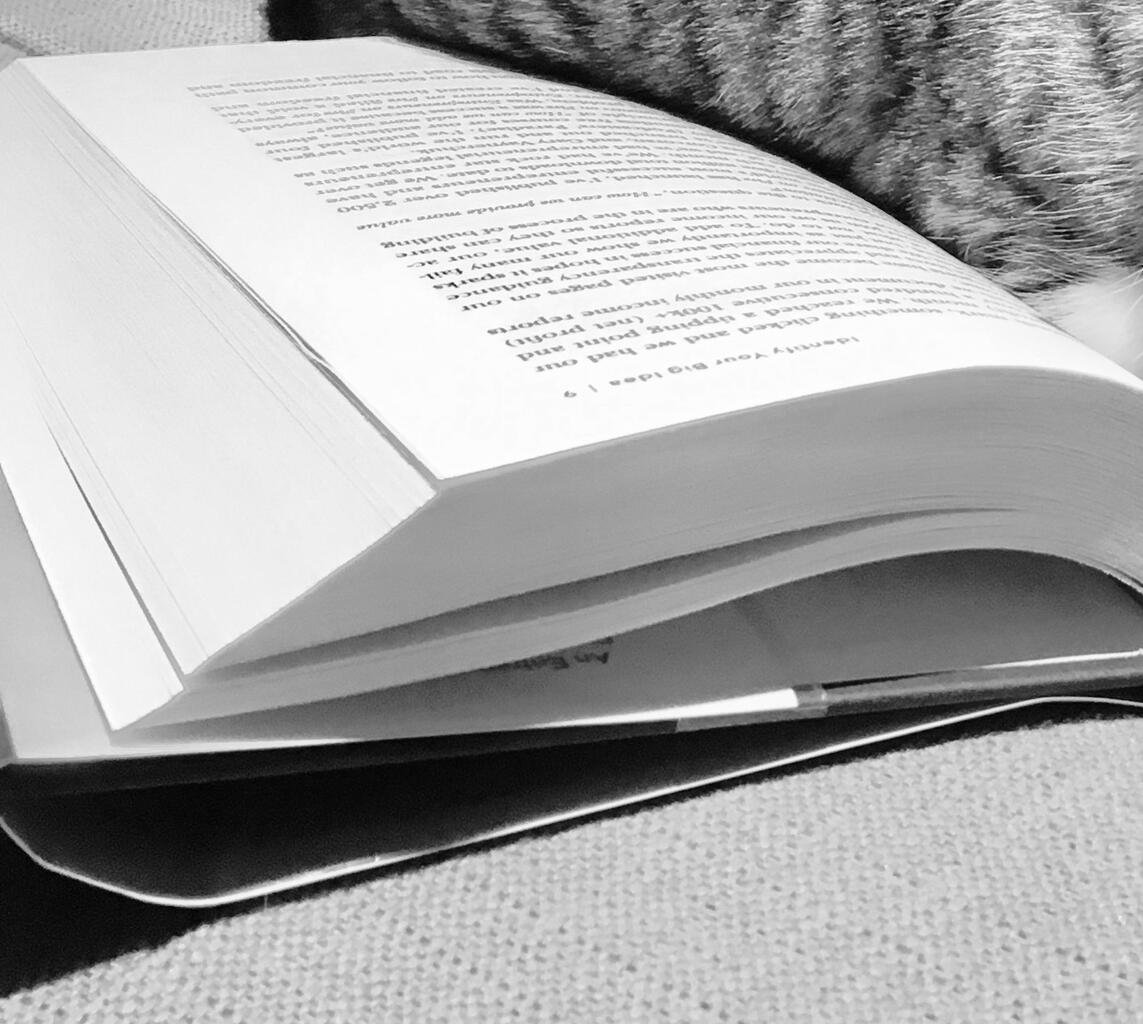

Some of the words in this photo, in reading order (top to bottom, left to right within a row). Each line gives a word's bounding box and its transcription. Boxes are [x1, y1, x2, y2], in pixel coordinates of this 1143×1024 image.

[432, 170, 580, 189] entrepreneurs
[383, 186, 425, 196] and
[455, 179, 558, 197] published
[326, 193, 378, 203] have
[403, 193, 449, 203] over
[337, 200, 397, 213] 2,500
[466, 200, 535, 214] provide
[417, 211, 463, 221] more
[508, 215, 588, 230] process
[356, 218, 413, 230] value
[590, 219, 666, 230] reports
[684, 224, 725, 232] add
[482, 227, 504, 235] of
[510, 231, 557, 241] they
[569, 227, 679, 245] additional
[683, 230, 803, 241] importantly
[380, 231, 480, 248] building
[463, 238, 503, 247] can
[711, 240, 802, 250] financial
[396, 245, 457, 258] share
[587, 242, 641, 253] show
[631, 246, 708, 258] success
[448, 252, 489, 262] our
[541, 251, 580, 259] our
[471, 257, 532, 270] many
[533, 259, 601, 272] hopes
[561, 257, 701, 281] transparency
[695, 264, 749, 273] most
[433, 273, 507, 289] sparks
[620, 271, 691, 285] visited
[775, 280, 811, 288] our
[447, 277, 554, 300] guidance
[548, 280, 613, 295] pages
[676, 285, 769, 302] monthly
[510, 293, 541, 301] on
[733, 288, 859, 306] consecutive
[461, 300, 502, 311] our
[582, 298, 671, 316] income
[656, 304, 723, 318] 100k+
[764, 300, 856, 316] reached
[825, 308, 943, 319] something
[488, 314, 574, 335] reports
[592, 316, 644, 329] (net
[647, 316, 736, 334] tipping
[739, 317, 820, 334] clicked
[505, 325, 586, 347] profit)
[573, 329, 641, 348] point
[684, 331, 730, 344] and
[646, 341, 677, 350] we
[774, 337, 860, 354] Identify
[517, 345, 565, 361] and
[588, 348, 638, 363] had
[717, 353, 769, 365] Your
[536, 359, 578, 372] our
[669, 363, 709, 374] Big
[610, 372, 663, 386] Idea
